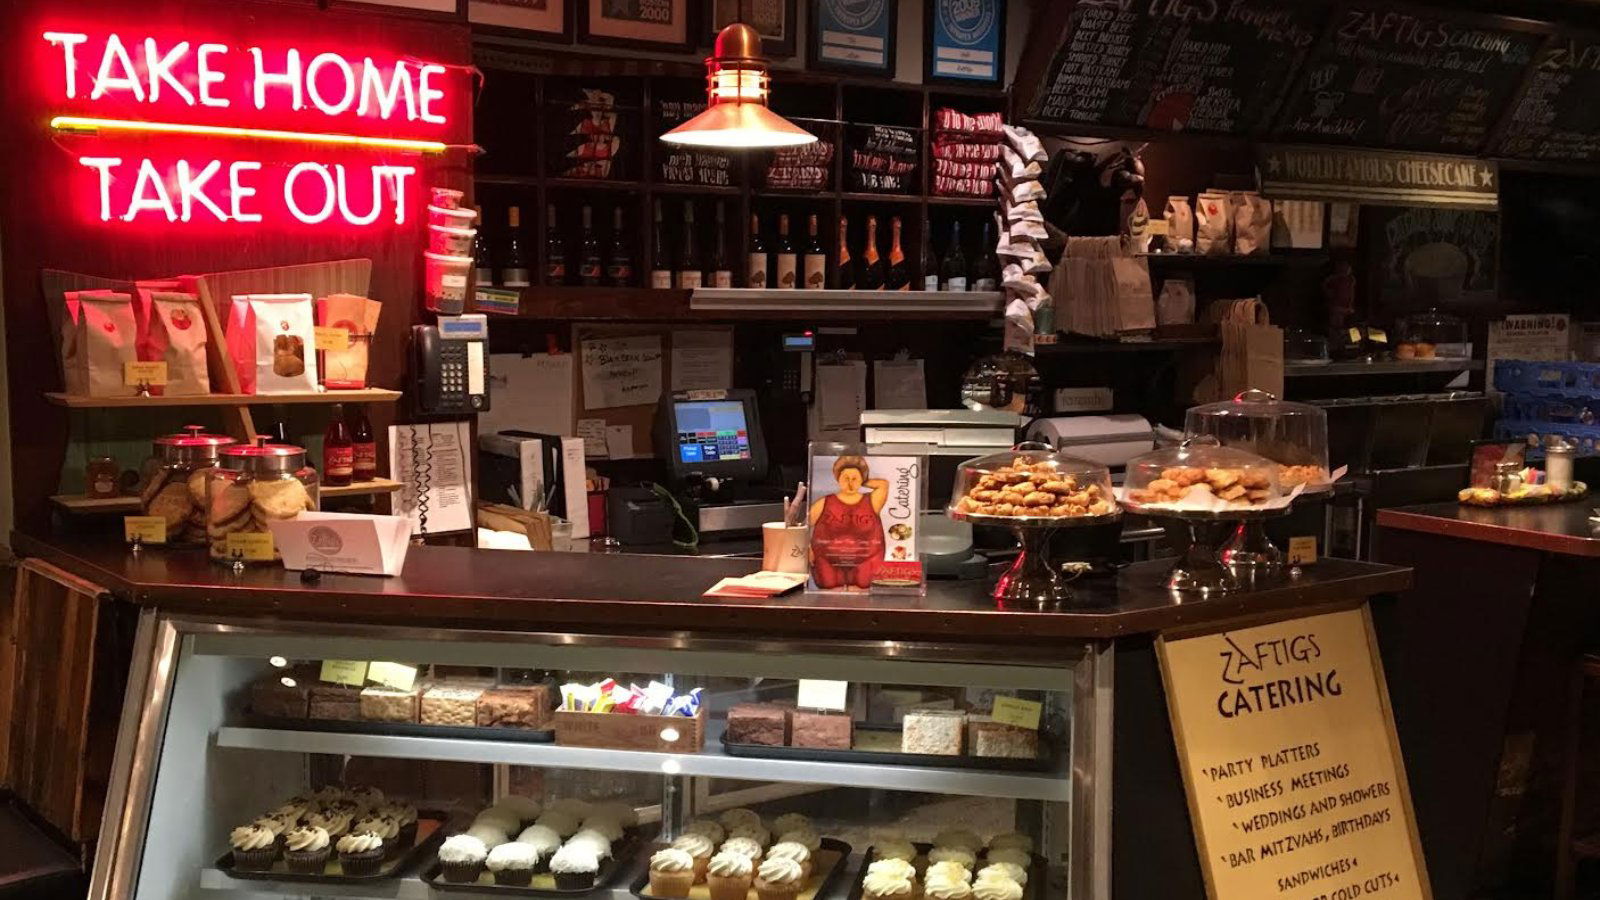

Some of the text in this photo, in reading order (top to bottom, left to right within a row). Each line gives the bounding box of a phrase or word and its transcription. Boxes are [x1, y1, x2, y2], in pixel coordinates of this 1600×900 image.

[639, 6, 669, 20] 2000
[1337, 11, 1449, 48] ZAFTIGS
[43, 32, 446, 124] TAKE HOME
[79, 157, 416, 225] TAKE OUT
[1285, 152, 1477, 188] WORLD FAMOUS CHEESECAKE
[888, 463, 919, 519] Catering
[1220, 632, 1321, 685] ZAFTIGS
[1217, 669, 1342, 719] CATERING
[1211, 742, 1321, 782] PARTY PLATTERS
[1225, 763, 1351, 810] BUSINESS MEETINGS
[1241, 781, 1391, 834] WEDDINGS AND SHOWERS
[1229, 808, 1392, 870] BAR MITZVAHS, BIRTHDAYS
[1277, 858, 1351, 893] SANDWICHES
[1363, 871, 1394, 894] CUTS
